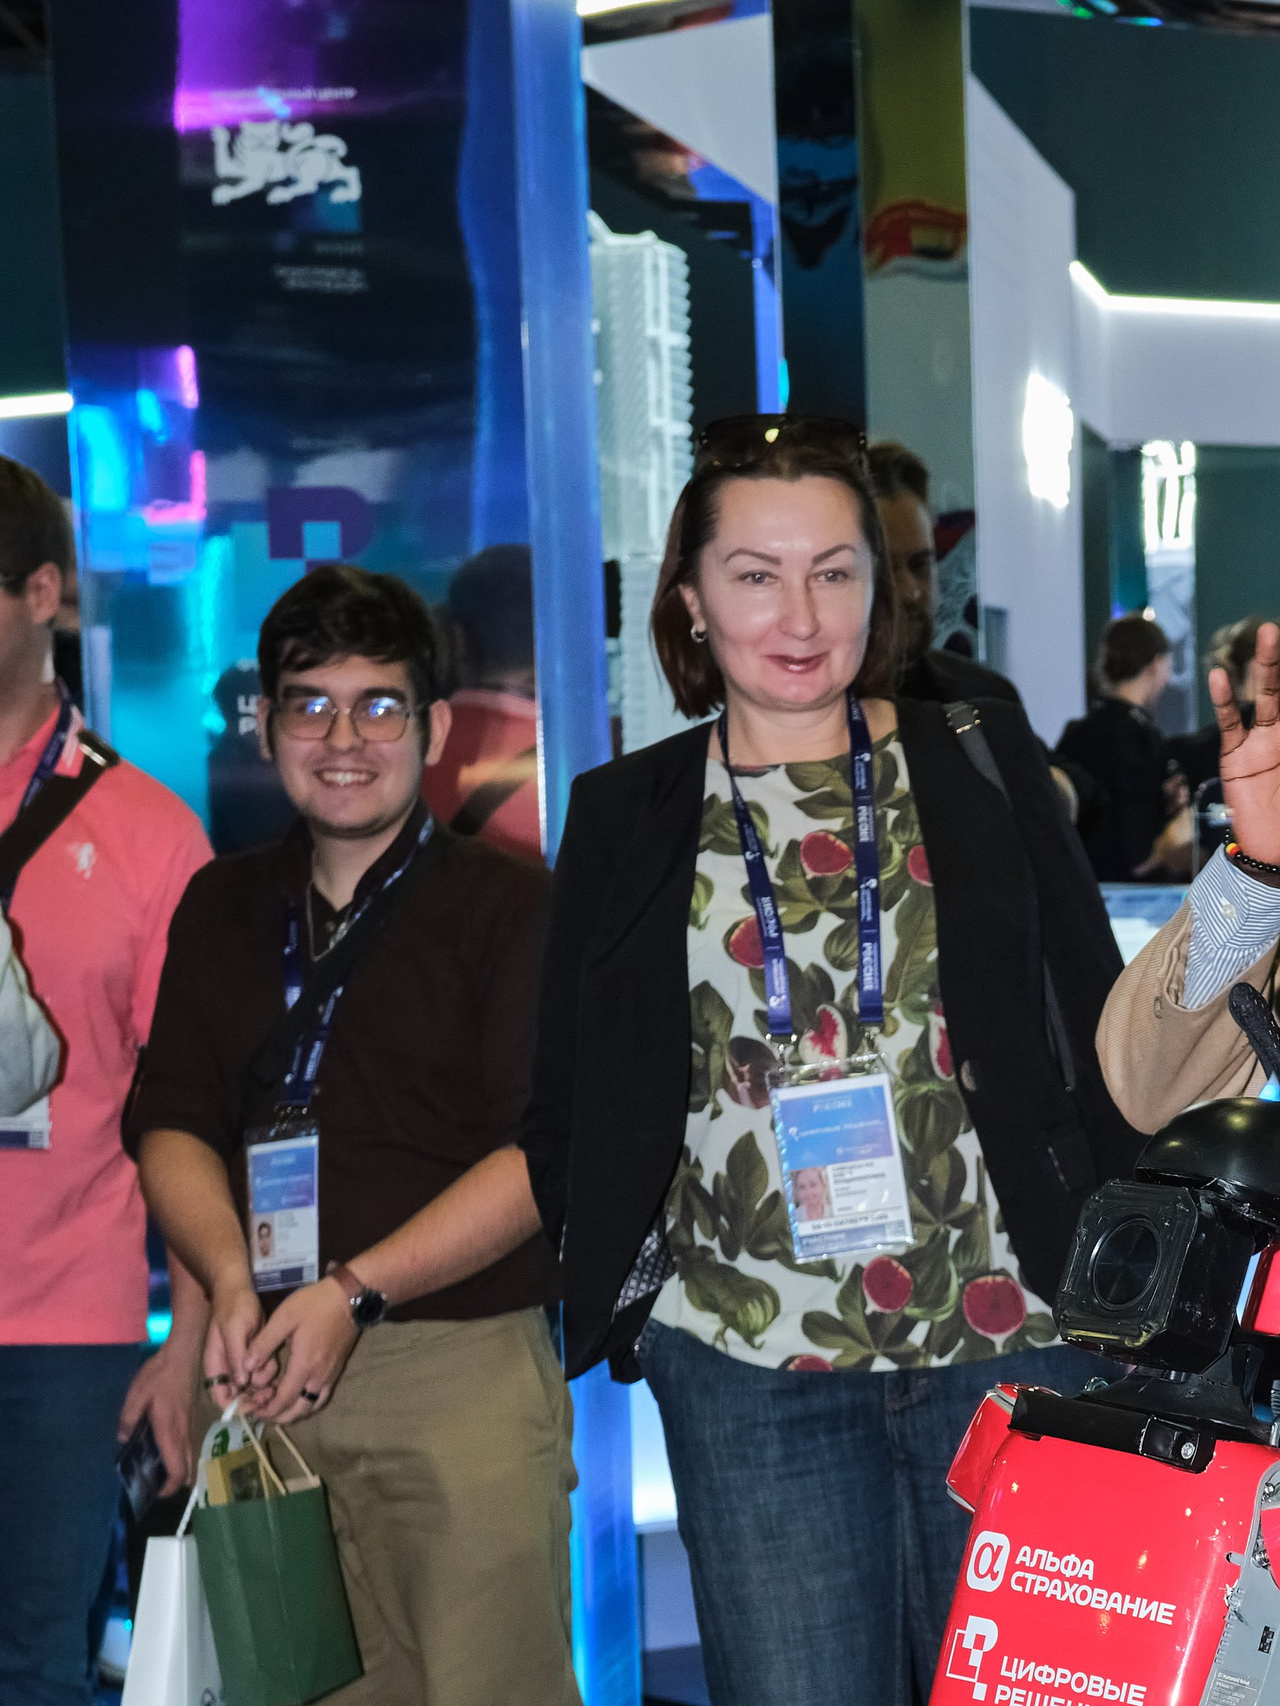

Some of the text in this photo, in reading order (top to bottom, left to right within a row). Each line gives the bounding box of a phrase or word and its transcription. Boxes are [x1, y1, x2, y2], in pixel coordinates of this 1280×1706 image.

[1015, 1545, 1095, 1581] АЛЬФА
[1010, 1570, 1177, 1626] СТРАХОВАНИЕ
[1000, 1655, 1147, 1706] ЦИФРОВЫЕ
